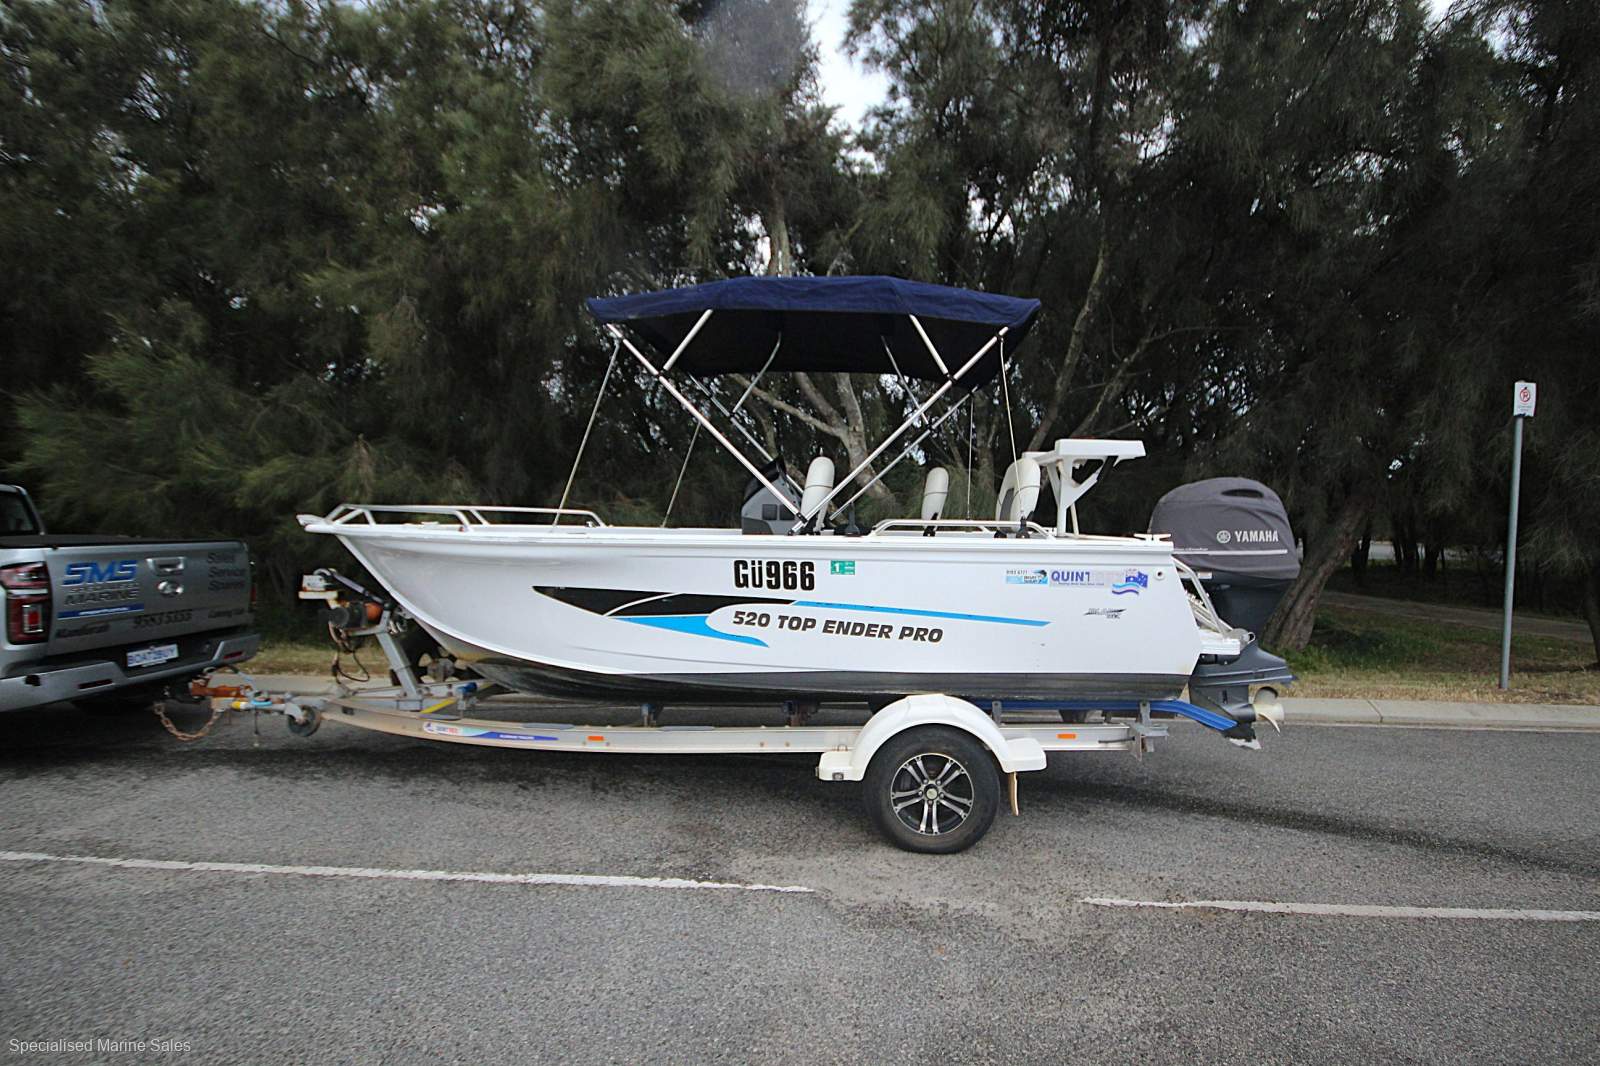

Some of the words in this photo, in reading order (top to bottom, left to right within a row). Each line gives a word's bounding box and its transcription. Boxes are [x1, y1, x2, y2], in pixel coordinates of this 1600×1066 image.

[1234, 530, 1279, 543] YAMAHA
[62, 559, 139, 586] SMS
[64, 590, 140, 606] MARINE
[733, 610, 771, 628] 520
[778, 615, 816, 632] TOP
[822, 620, 894, 639] ENDER
[898, 626, 944, 643] PRO
